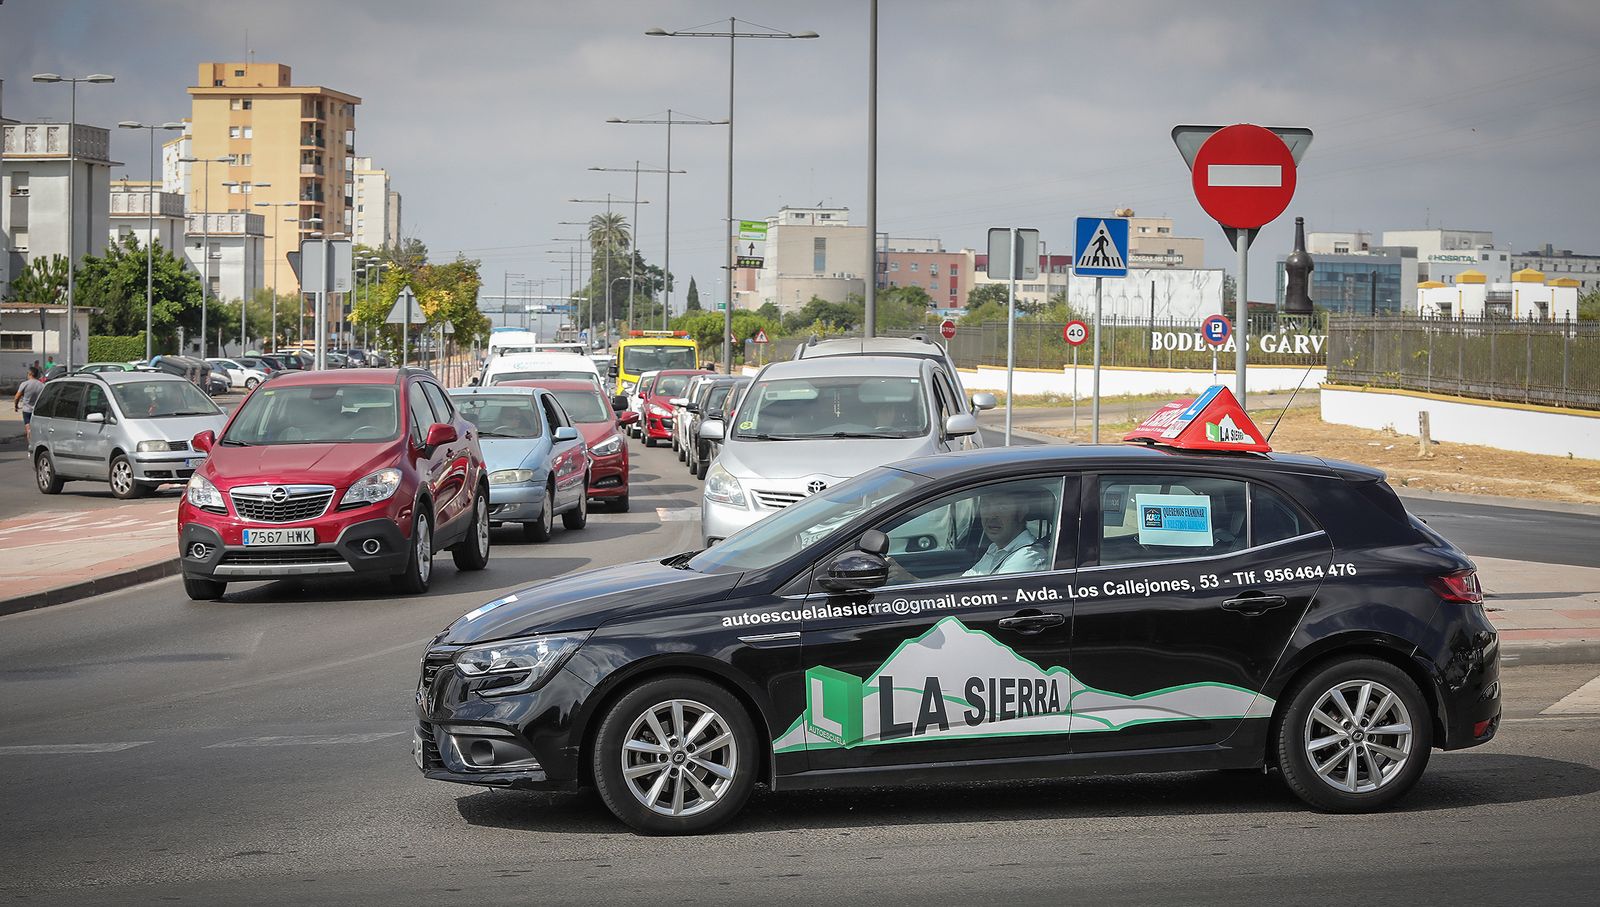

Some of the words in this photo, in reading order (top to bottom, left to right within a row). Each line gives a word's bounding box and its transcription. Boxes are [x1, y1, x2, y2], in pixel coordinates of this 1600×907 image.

[1433, 254, 1477, 263] HOSPITAL
[1068, 328, 1083, 337] 40
[1213, 323, 1220, 331] P
[1220, 426, 1230, 442] LA
[1163, 507, 1184, 518] QUEREMOS
[1185, 508, 1204, 518] EXAMINAR
[251, 531, 283, 544] 7567
[287, 530, 311, 543] HWK
[722, 593, 997, 628] autoescuelalasierra@gmail.com
[1015, 586, 1062, 603] Avda.
[1068, 584, 1099, 599] Los
[1103, 579, 1196, 597] Callejones,
[1200, 573, 1219, 589] 53
[1233, 570, 1261, 586] Tlf.
[1328, 562, 1357, 578] 476
[878, 675, 950, 741] LA
[963, 676, 1061, 728] SIERRA
[808, 725, 847, 746] AUTOESCUELA
